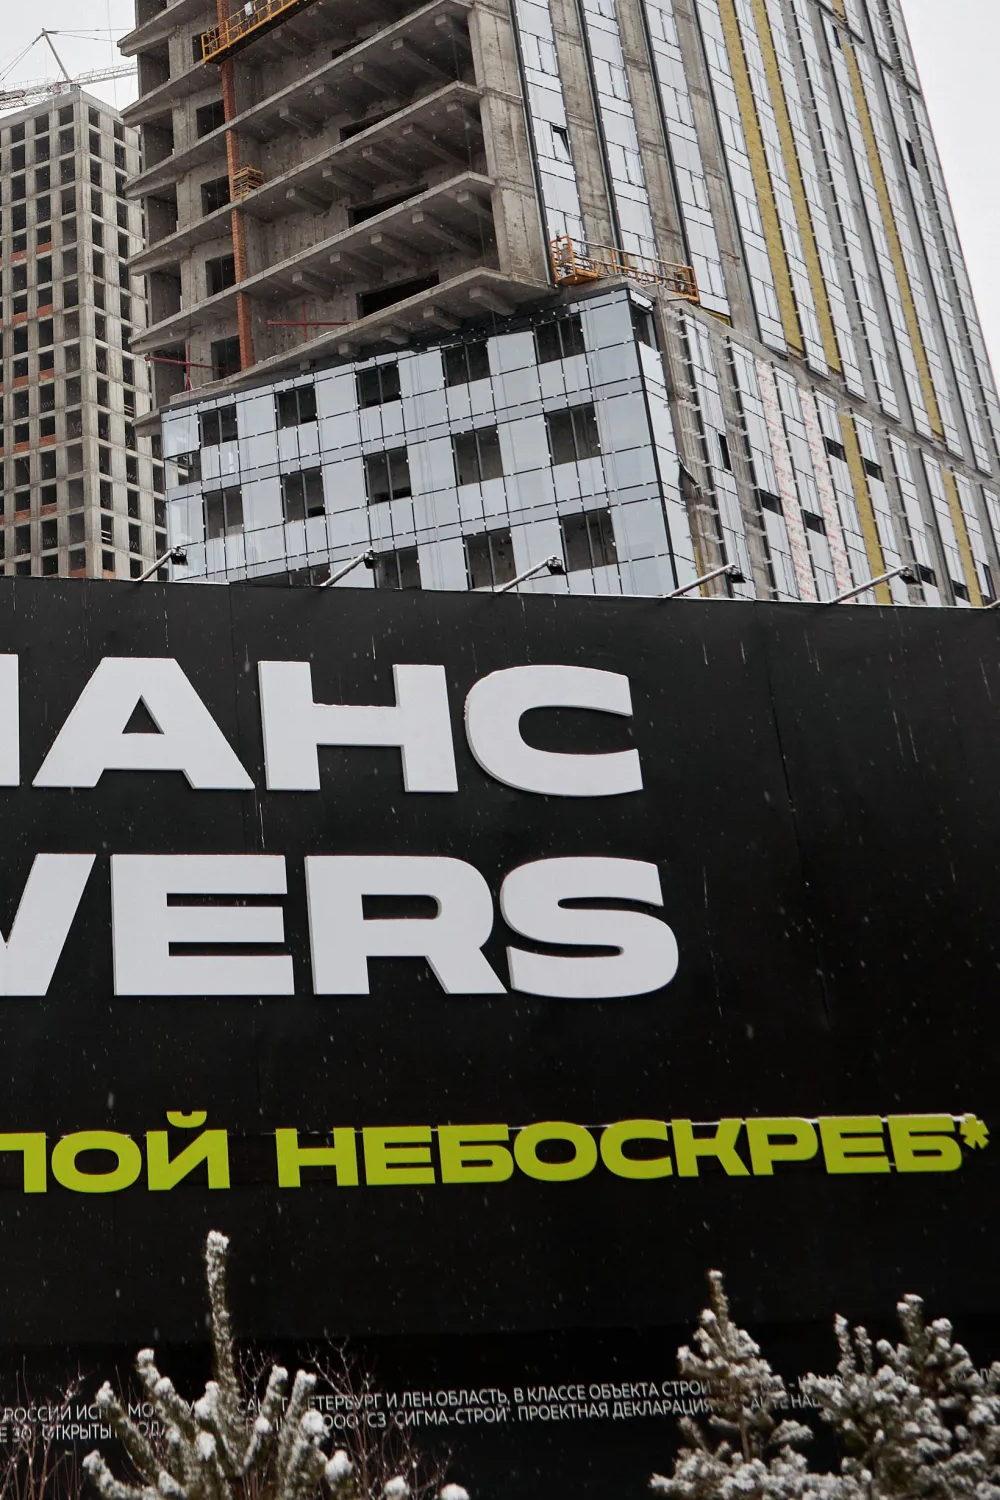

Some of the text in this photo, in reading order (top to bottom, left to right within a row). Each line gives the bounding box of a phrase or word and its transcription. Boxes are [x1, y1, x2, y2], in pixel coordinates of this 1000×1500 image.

[1, 1404, 72, 1424] РОССИИ
[385, 1392, 398, 1409] И
[513, 1386, 524, 1404] В
[527, 1384, 586, 1403] КЛАССЕ
[588, 1380, 659, 1401] ОБЪЕКТА
[517, 1402, 609, 1422] ПРОЕКТНАЯ
[612, 1397, 713, 1420] ДЕКЛАРАЦИЯ
